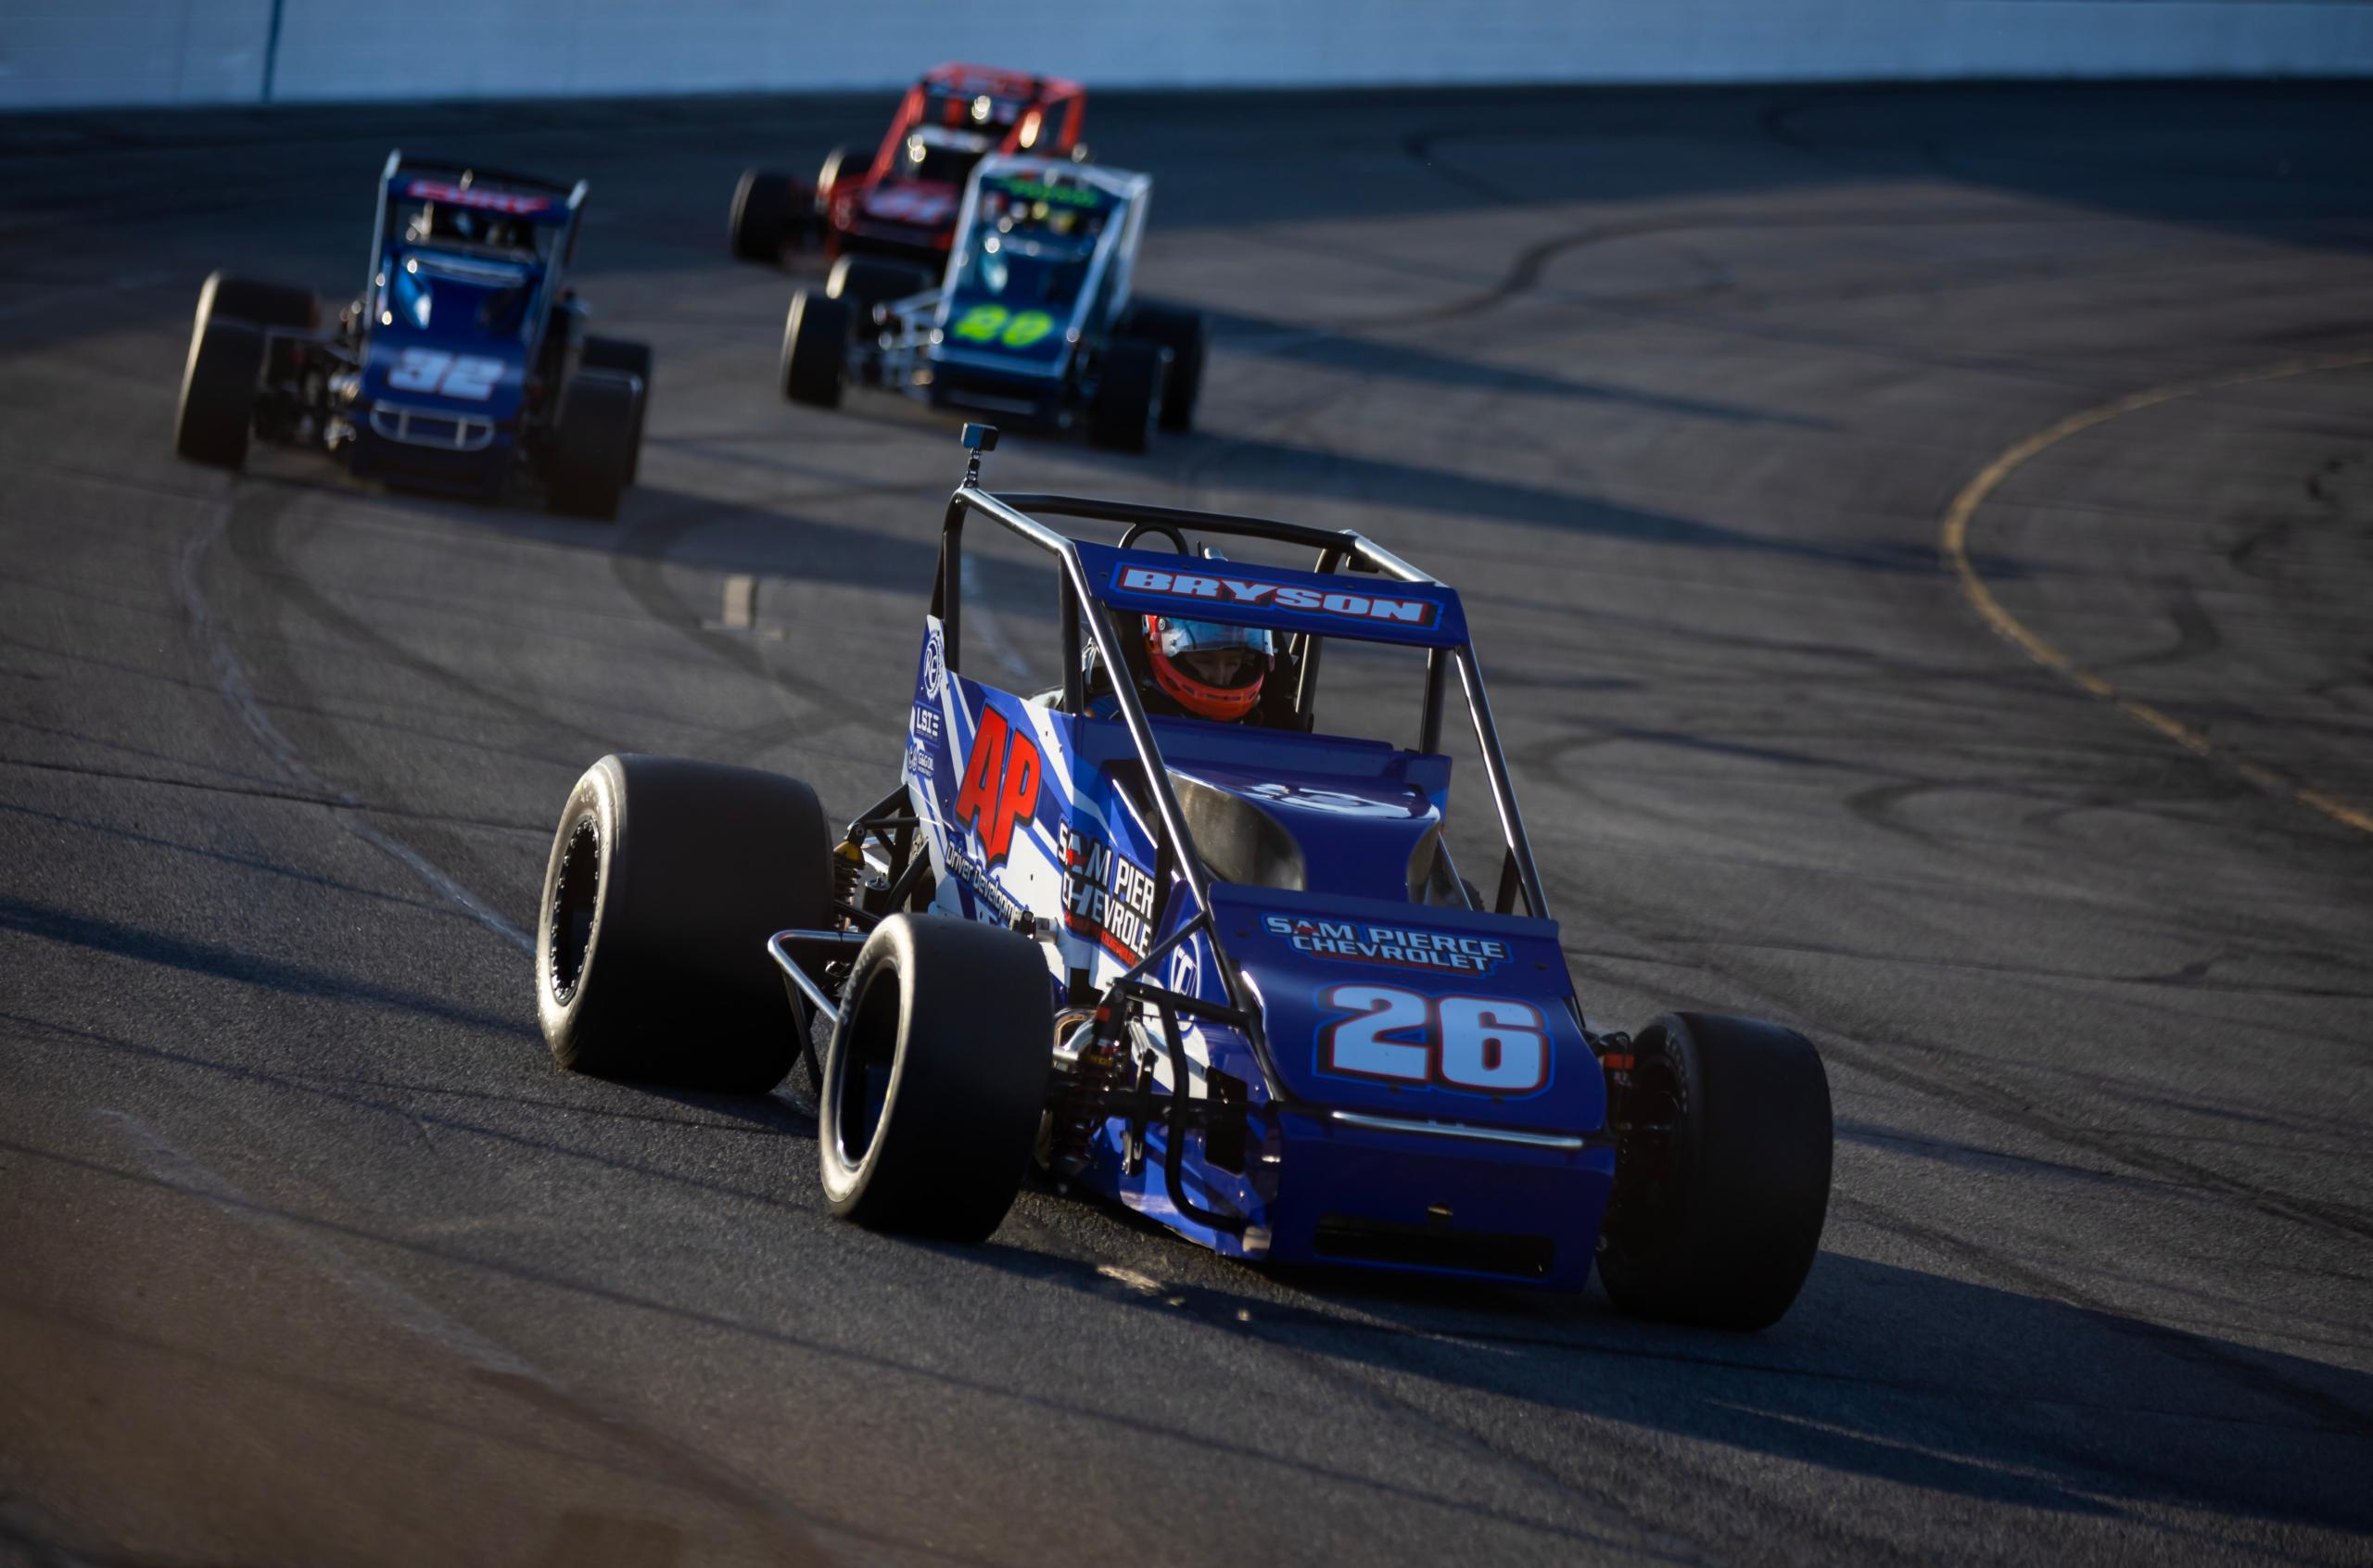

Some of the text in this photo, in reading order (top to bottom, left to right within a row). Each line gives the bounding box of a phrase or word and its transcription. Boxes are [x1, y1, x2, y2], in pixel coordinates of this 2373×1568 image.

[1123, 568, 1425, 623] BRYSON
[956, 705, 1041, 863] AP
[945, 840, 973, 882] Driver
[1058, 821, 1155, 920] SAM PIER
[1062, 870, 1152, 960] CHEVROLE
[1266, 917, 1505, 959] SAM PIERCE
[1291, 934, 1488, 971] CHEVROLET
[1329, 984, 1544, 1091] 26
